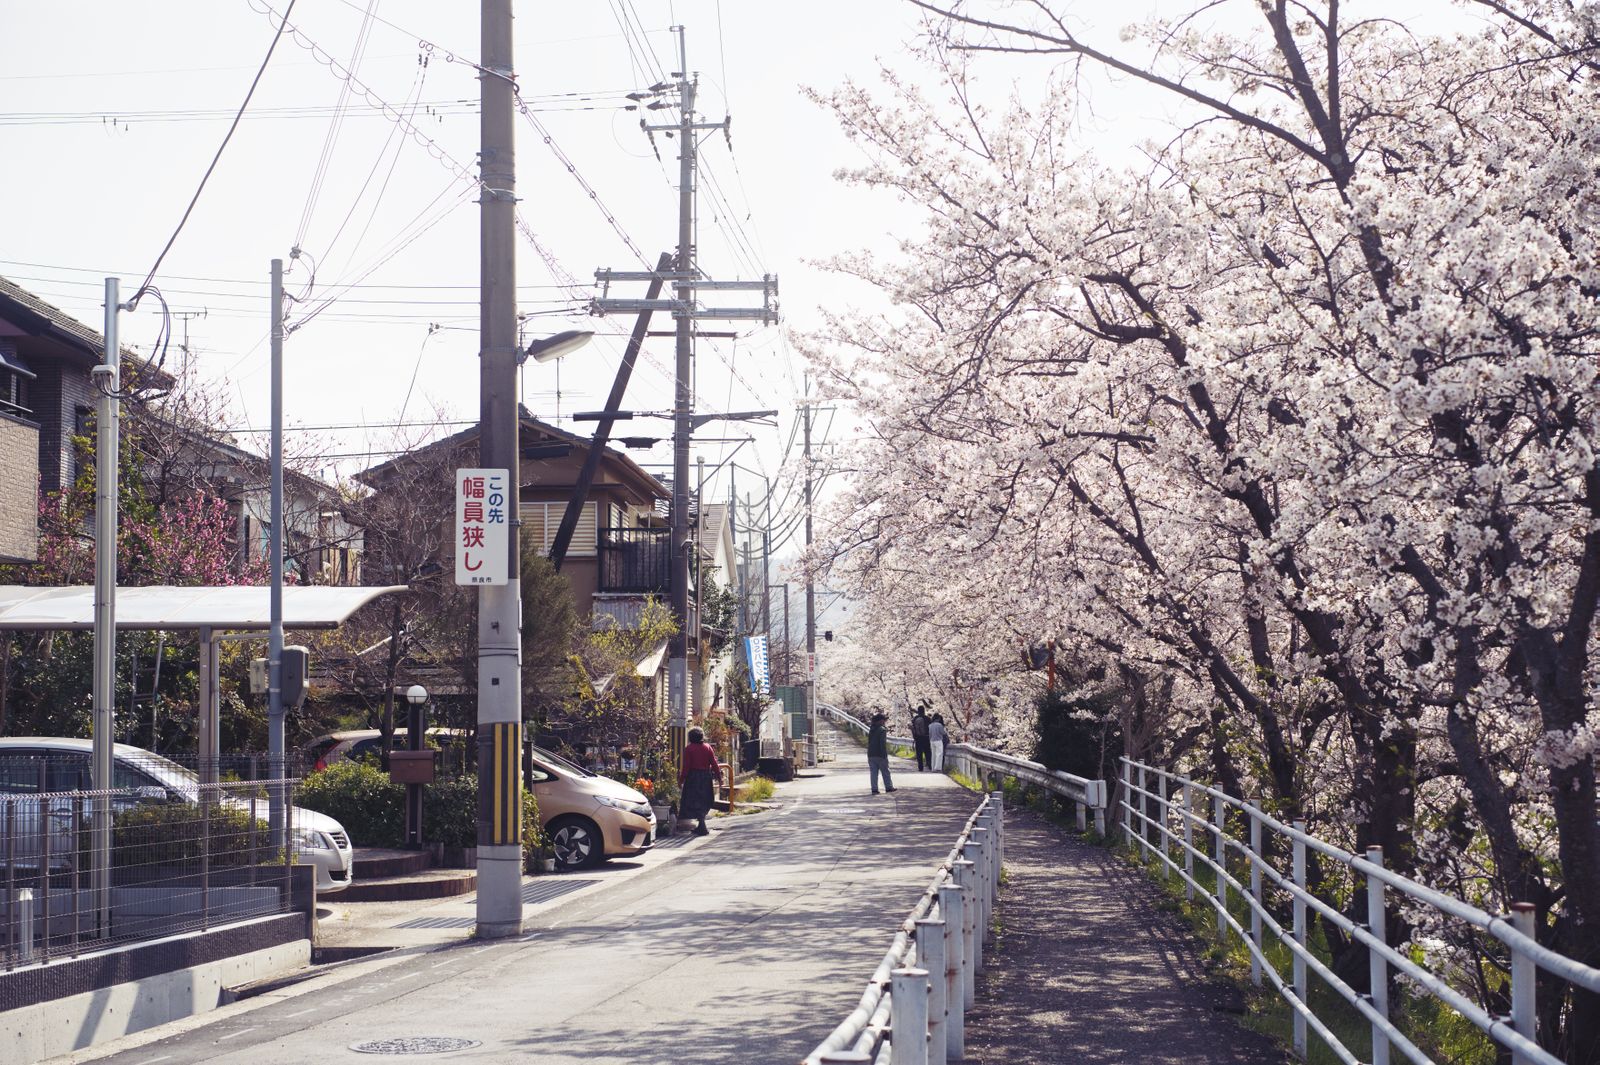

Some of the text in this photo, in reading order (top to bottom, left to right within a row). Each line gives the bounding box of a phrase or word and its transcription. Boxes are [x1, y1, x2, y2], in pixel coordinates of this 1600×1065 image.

[463, 477, 485, 571] 幅員狭し
[488, 477, 504, 524] この先
